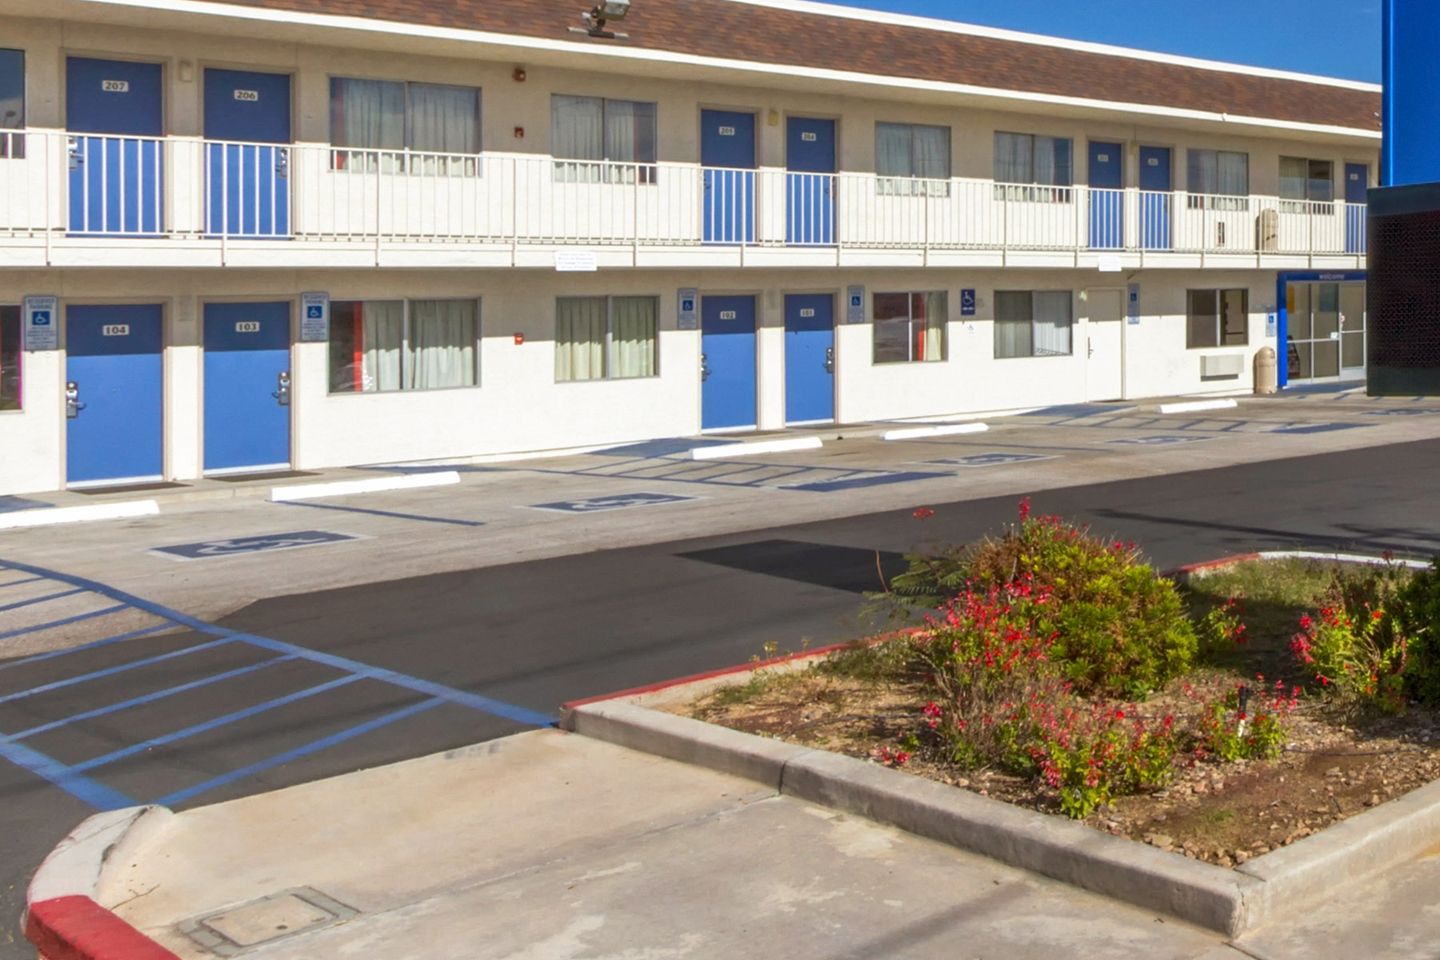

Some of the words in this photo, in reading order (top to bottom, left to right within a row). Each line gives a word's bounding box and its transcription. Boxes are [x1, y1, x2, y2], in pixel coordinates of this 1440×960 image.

[104, 81, 126, 91] 207
[236, 91, 256, 100] 206
[106, 325, 126, 335] 104
[238, 323, 257, 331] 103
